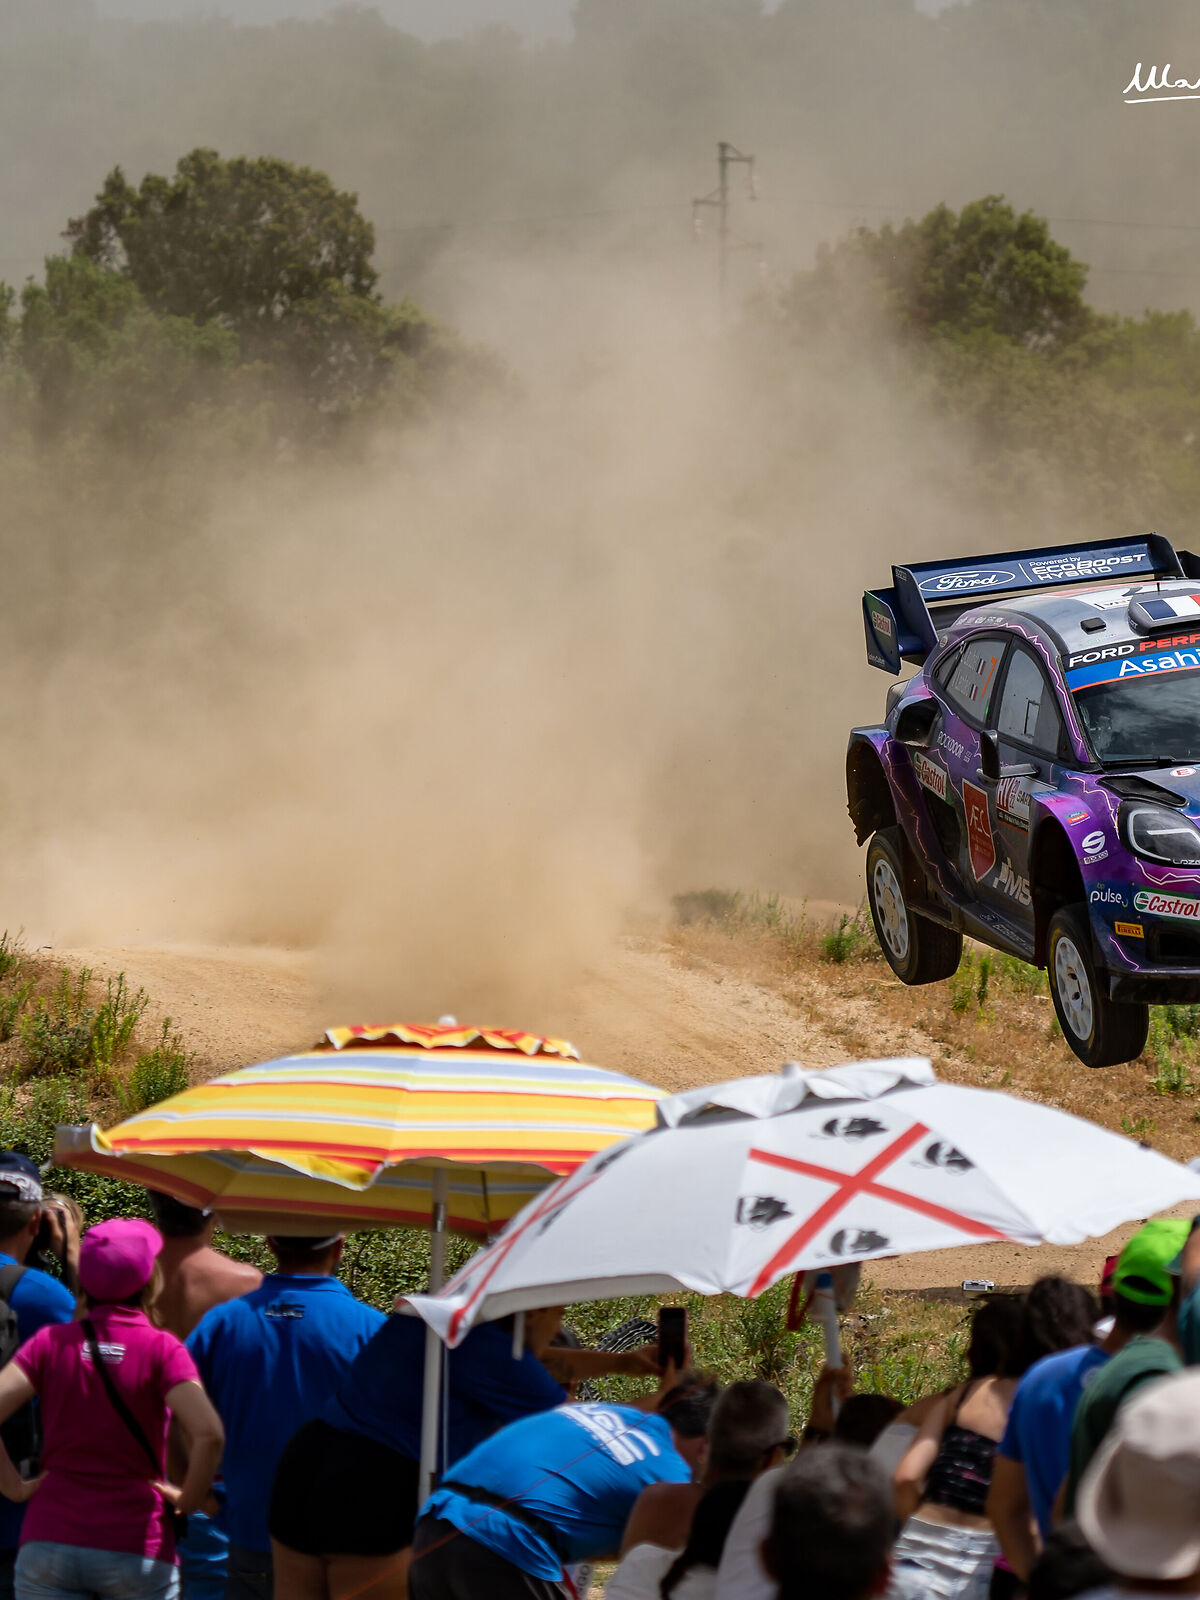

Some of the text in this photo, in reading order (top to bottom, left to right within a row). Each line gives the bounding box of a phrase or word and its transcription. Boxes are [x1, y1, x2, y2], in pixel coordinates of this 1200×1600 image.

[1029, 558, 1068, 567] Powered
[1031, 553, 1147, 575] ECOBOOST
[936, 573, 999, 590] Ford
[1037, 566, 1113, 581] HYBRID
[1069, 645, 1135, 668] FORD
[921, 760, 945, 796] Castrol
[1090, 888, 1123, 904] pulse
[1148, 896, 1200, 917] Castrol
